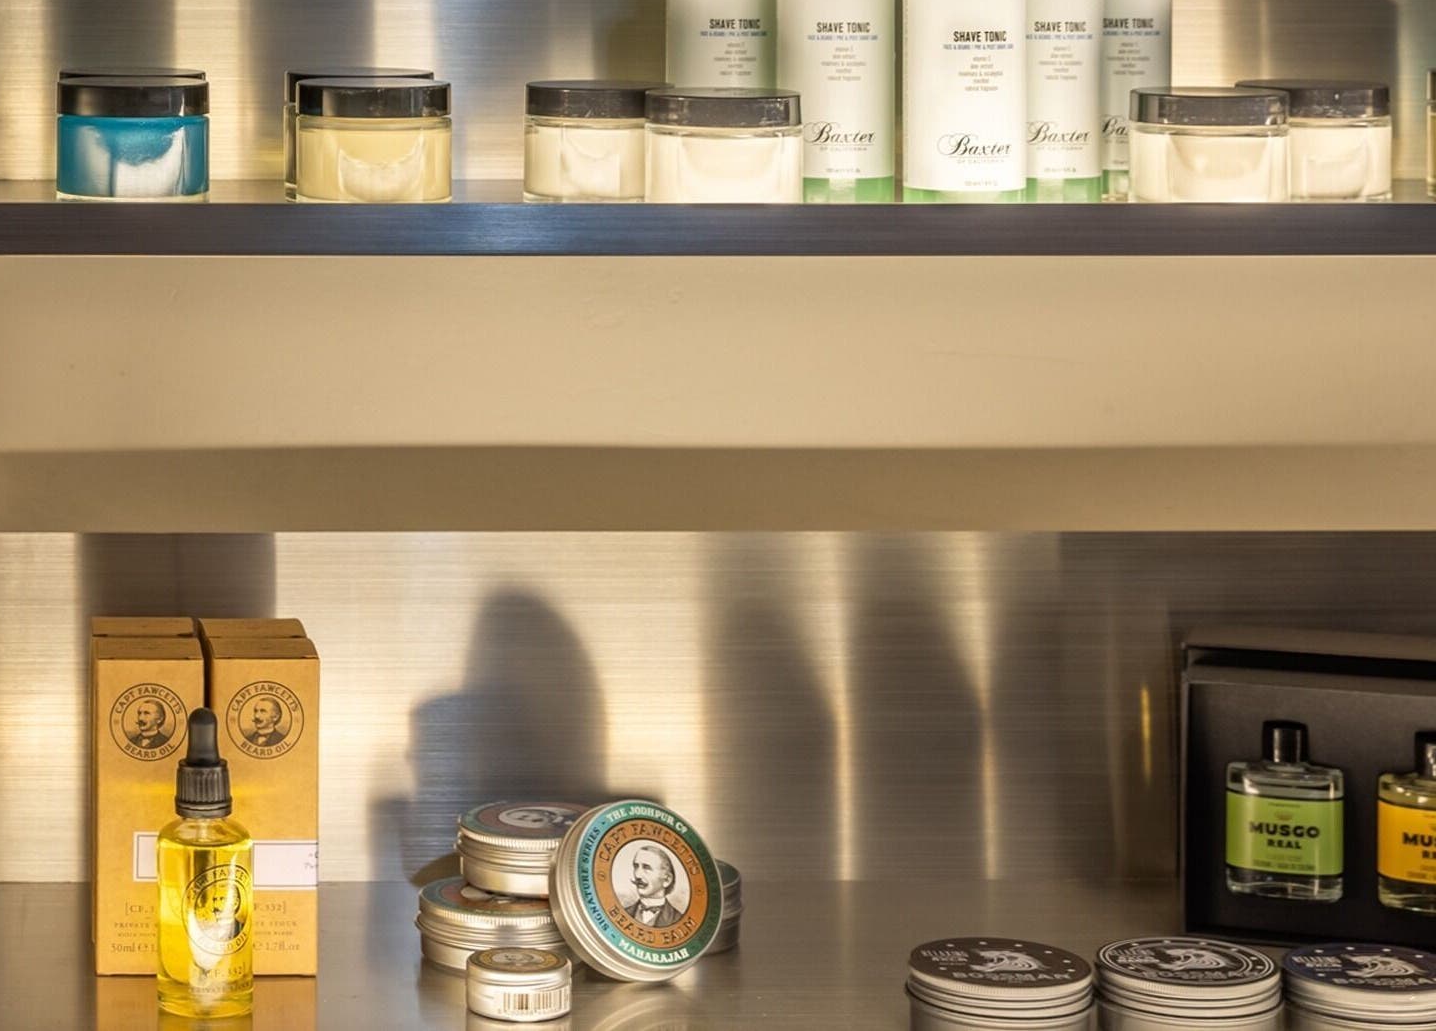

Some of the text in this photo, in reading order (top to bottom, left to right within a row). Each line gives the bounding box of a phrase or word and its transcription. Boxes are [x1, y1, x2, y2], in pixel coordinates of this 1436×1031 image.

[709, 19, 760, 30] SHAVE TONIC
[817, 22, 870, 33] SHAVE TONIC
[1034, 21, 1086, 32] SHAVE TONIC
[1103, 18, 1153, 29] SHAVE TONIC
[953, 31, 1007, 43] SHAVE TONIC
[805, 122, 876, 144] Baxter
[1027, 120, 1091, 144] Baxter
[937, 132, 1012, 156] Baxter
[114, 688, 137, 714] CAPT
[232, 686, 252, 712] CAPT
[124, 741, 175, 759] BEARD OIL
[240, 740, 291, 756] BEARD OIL
[607, 807, 675, 826] THE JODHPUR
[1249, 821, 1320, 838] MUSGO
[599, 827, 628, 861] CAPT
[1267, 839, 1302, 850] REAL
[582, 827, 610, 932] SIGNATURE SERIES
[609, 906, 697, 945] BEARD BALM
[619, 940, 690, 963] MAHARAJAH
